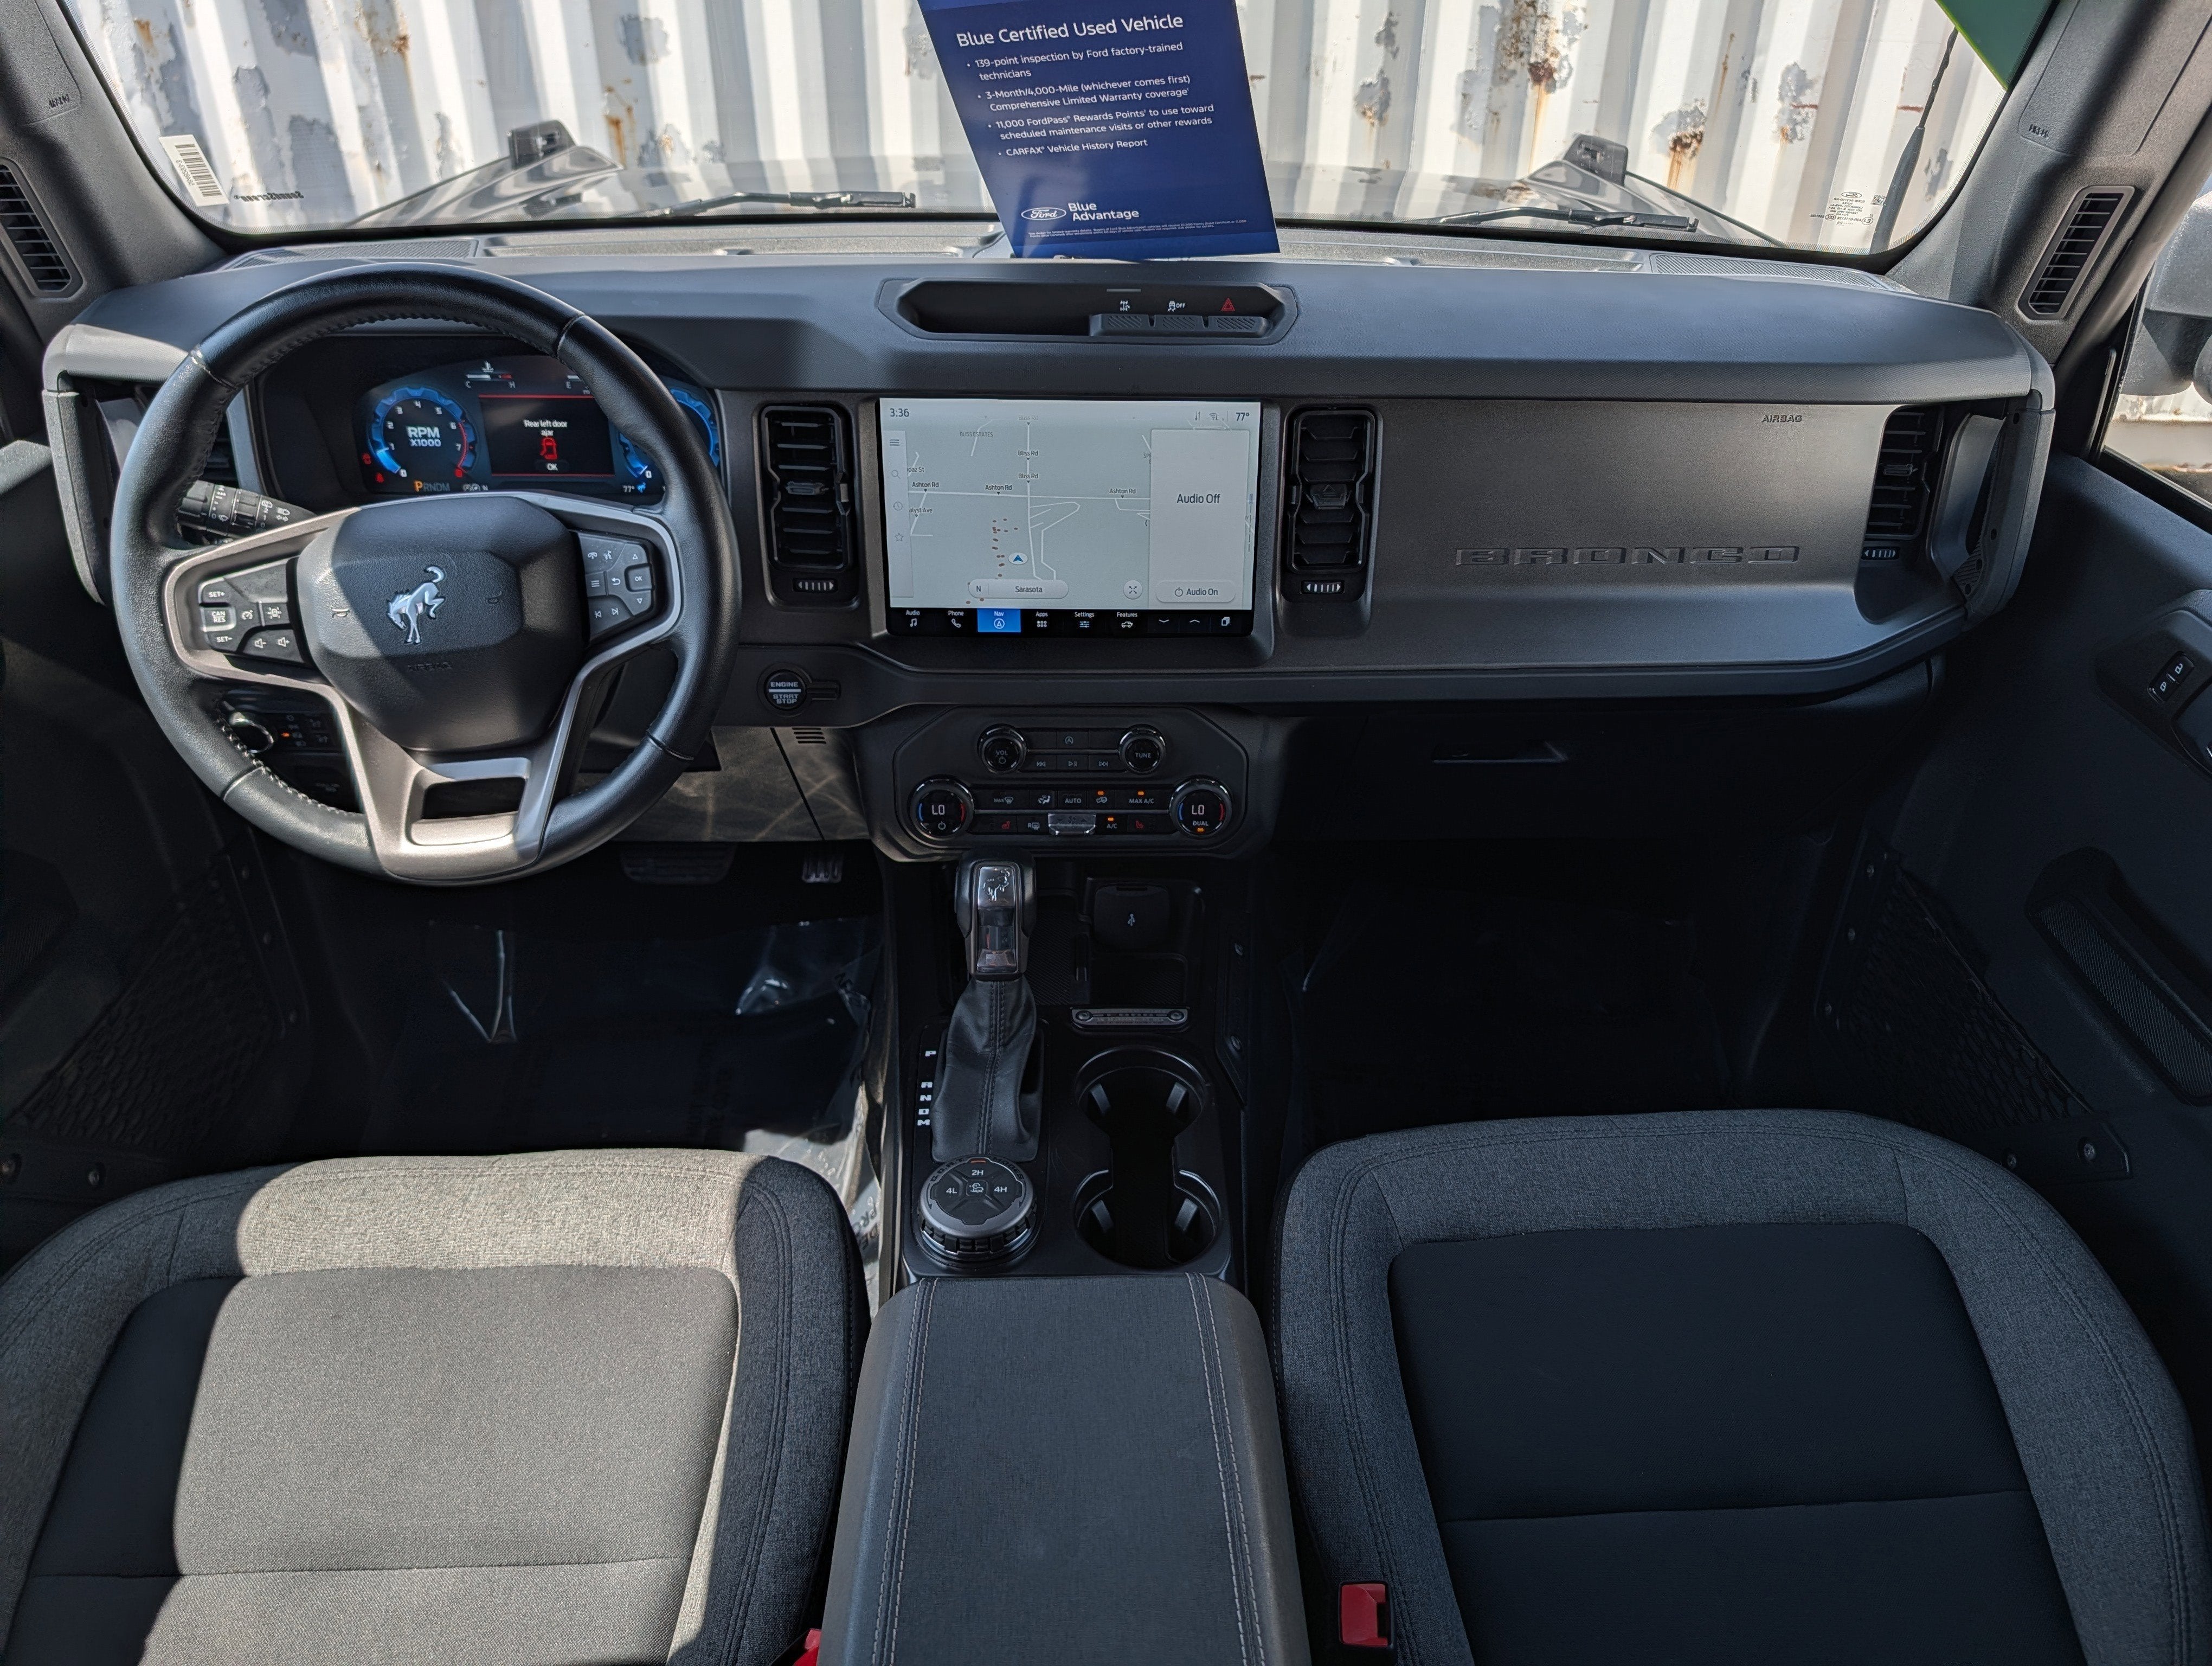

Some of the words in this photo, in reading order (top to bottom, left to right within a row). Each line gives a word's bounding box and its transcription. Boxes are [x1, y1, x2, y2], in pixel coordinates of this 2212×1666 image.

[956, 31, 995, 47] Blue
[998, 22, 1069, 43] Certified
[1073, 19, 1117, 36] Used
[1121, 14, 1184, 32] Vehicle
[975, 56, 1019, 68] 139-point
[1020, 53, 1070, 64] inspection
[1071, 51, 1084, 60] by
[1086, 48, 1109, 58] Ford
[1111, 41, 1184, 56] factory-trained
[979, 69, 1031, 80] technicians
[985, 84, 1078, 99] 3-Month/4,000-Mile
[1081, 80, 1132, 93] (whichever
[1134, 78, 1166, 87] comes
[1168, 75, 1191, 84] first)
[989, 99, 1060, 111] Comprehensive
[1062, 95, 1097, 105] Limited
[1099, 91, 1142, 102] Warranty
[995, 119, 1025, 129] 11,000
[1073, 112, 1114, 123] Rewards
[1180, 104, 1214, 114] toward
[1000, 129, 1047, 140] scheduled
[1049, 125, 1107, 137] maintenance
[1108, 123, 1133, 131] visits
[1147, 120, 1172, 129] other
[1174, 117, 1213, 126] rewards
[1047, 143, 1080, 153] Vehicle
[1082, 140, 1114, 151] History
[1116, 139, 1148, 149] Report
[1068, 202, 1097, 212] Blue
[1072, 210, 1139, 221] Advantage
[413, 400, 421, 408] 4
[394, 406, 403, 414] 3
[434, 406, 442, 415] 5
[890, 408, 910, 417] 3:36
[1236, 412, 1250, 421] 77°
[1761, 414, 1803, 423] AIRBAG
[386, 421, 394, 429] 2
[449, 421, 456, 430] 6
[523, 419, 539, 428] Rear
[539, 419, 552, 428] left
[552, 419, 568, 428] door
[407, 426, 440, 438] RPM
[455, 443, 462, 451] 7
[546, 463, 558, 471] OK
[399, 469, 407, 477] 0
[1176, 494, 1204, 503] Audio
[1206, 494, 1221, 503] Off
[1456, 546, 1800, 566] BRONCO
[931, 804, 946, 815] LO
[1191, 804, 1205, 815] LO
[992, 1157, 1025, 1180] MODES
